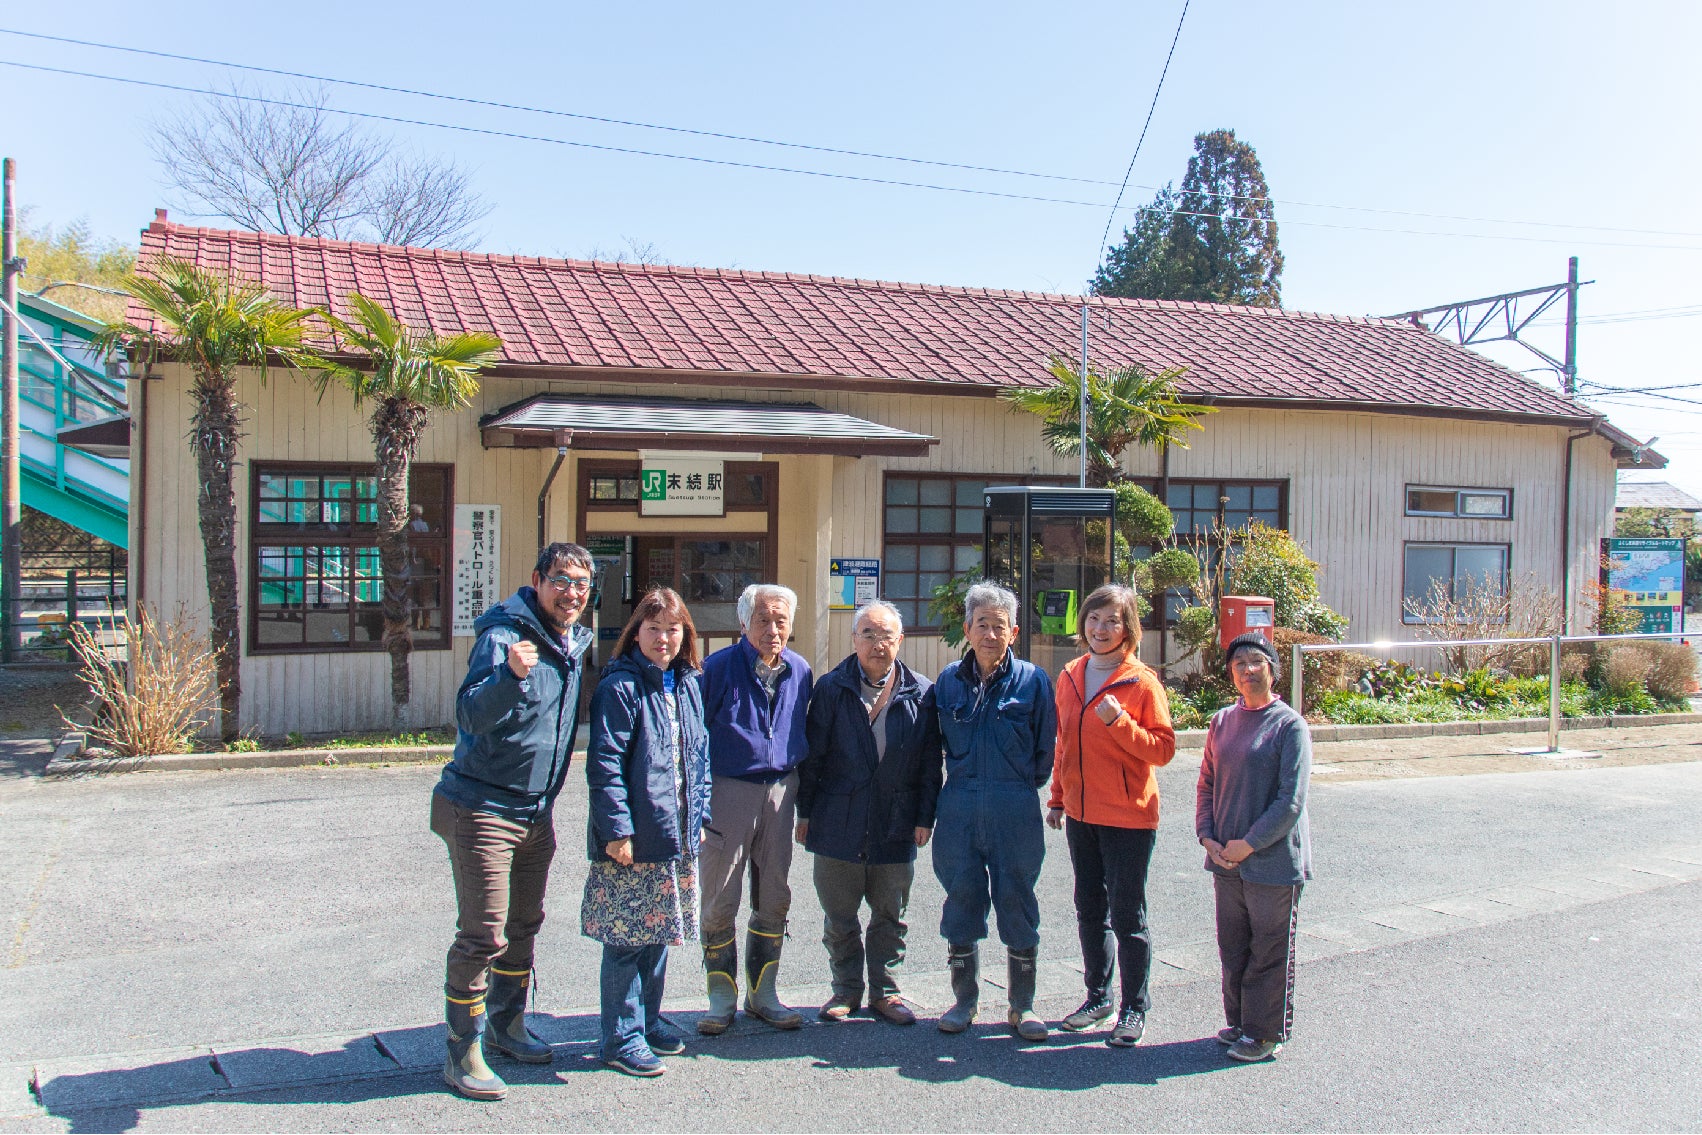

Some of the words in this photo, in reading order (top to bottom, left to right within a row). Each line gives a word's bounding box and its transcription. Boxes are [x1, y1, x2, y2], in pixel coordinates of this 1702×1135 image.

[642, 472, 661, 493] JR
[667, 473, 722, 490] 末続駅
